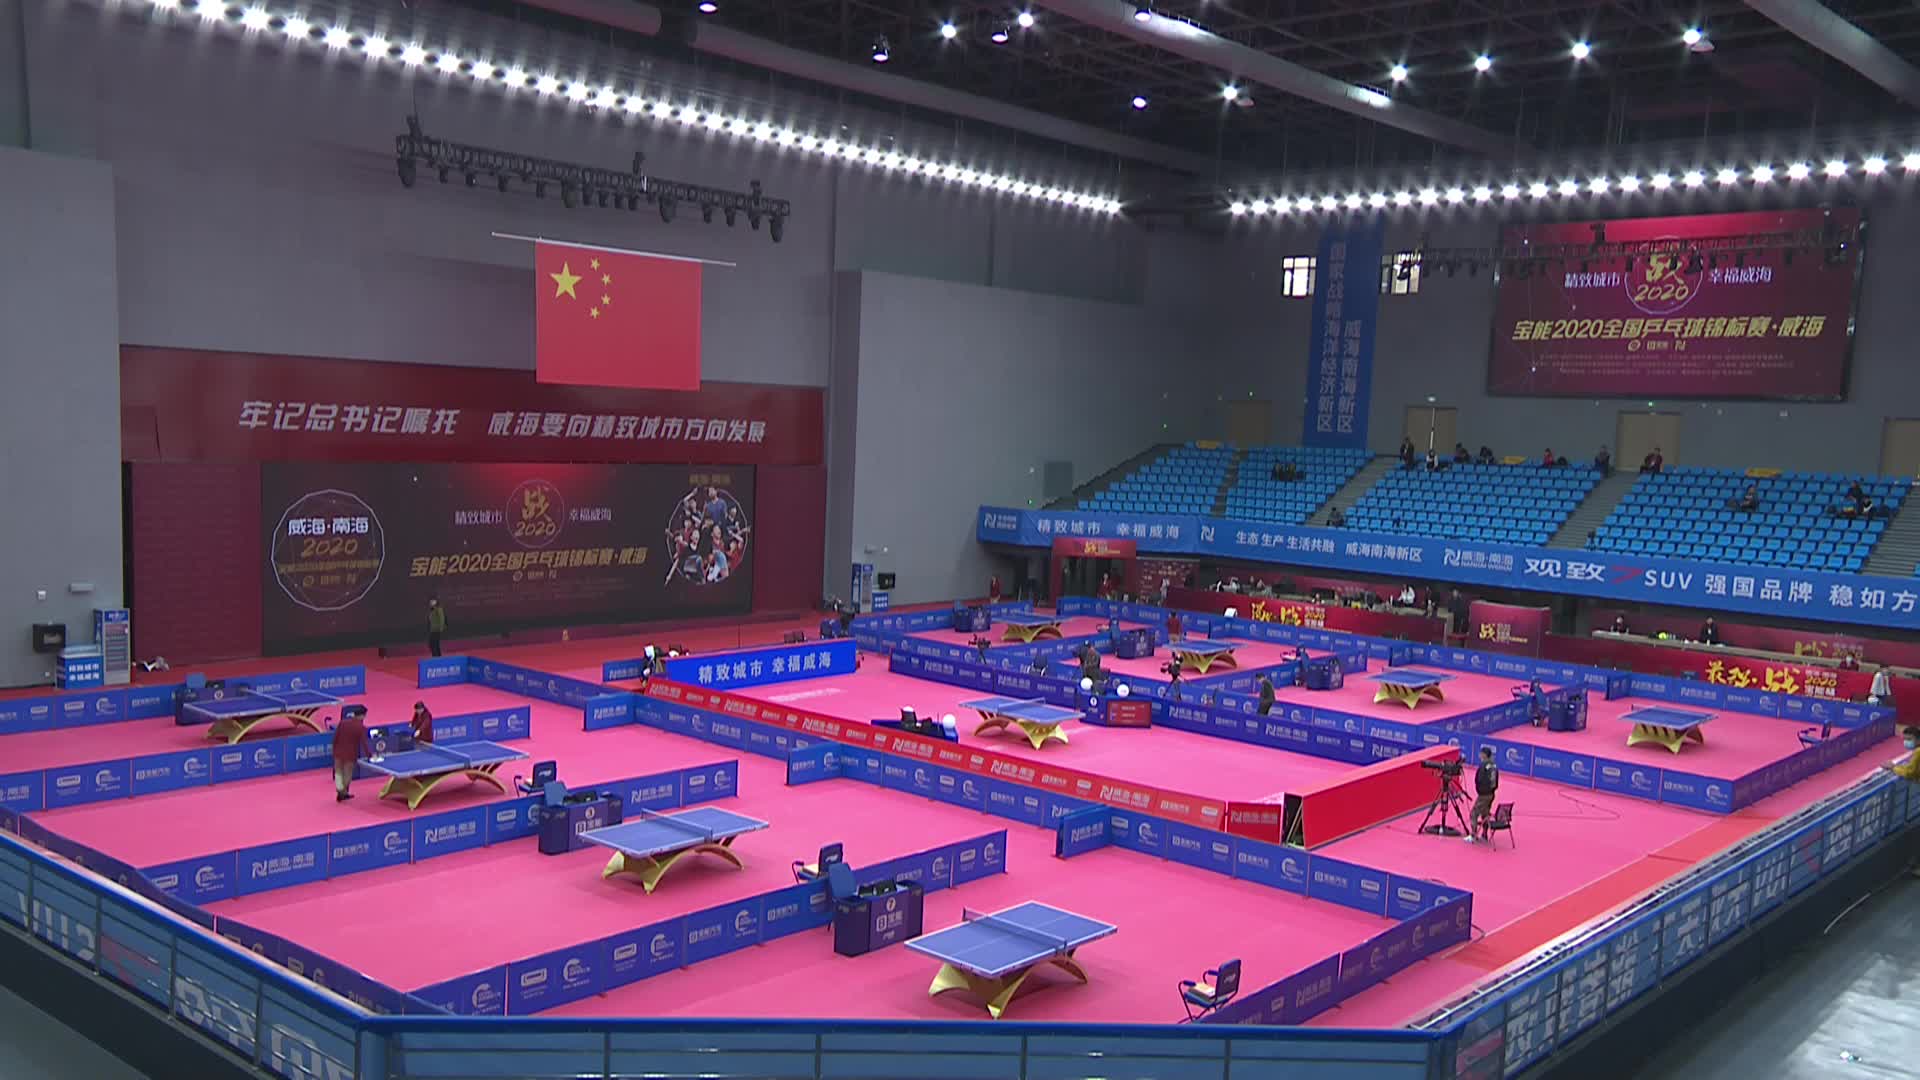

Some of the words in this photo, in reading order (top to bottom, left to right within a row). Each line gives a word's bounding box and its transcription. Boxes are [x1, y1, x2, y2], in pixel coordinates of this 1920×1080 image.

[1564, 271, 1620, 288] 精致城市
[1708, 265, 1772, 284] 幸福威海
[1634, 283, 1689, 301] 2020
[239, 401, 460, 436] 牢记总书记嘱托
[487, 411, 767, 443] 威海要向精致城市方向发展
[288, 517, 369, 536] 威海·南海
[515, 520, 556, 537] 2020
[1037, 519, 1100, 536] 精致城市
[1117, 524, 1180, 539] 幸福威海
[303, 538, 358, 557] 2020
[1345, 542, 1422, 562] 威海南海新区
[1644, 569, 1692, 590] SUV
[1704, 574, 1813, 603] 强国品牌
[1829, 584, 1918, 612] 稳如方
[698, 661, 763, 684] 精致城市
[772, 651, 831, 675] 幸福威海
